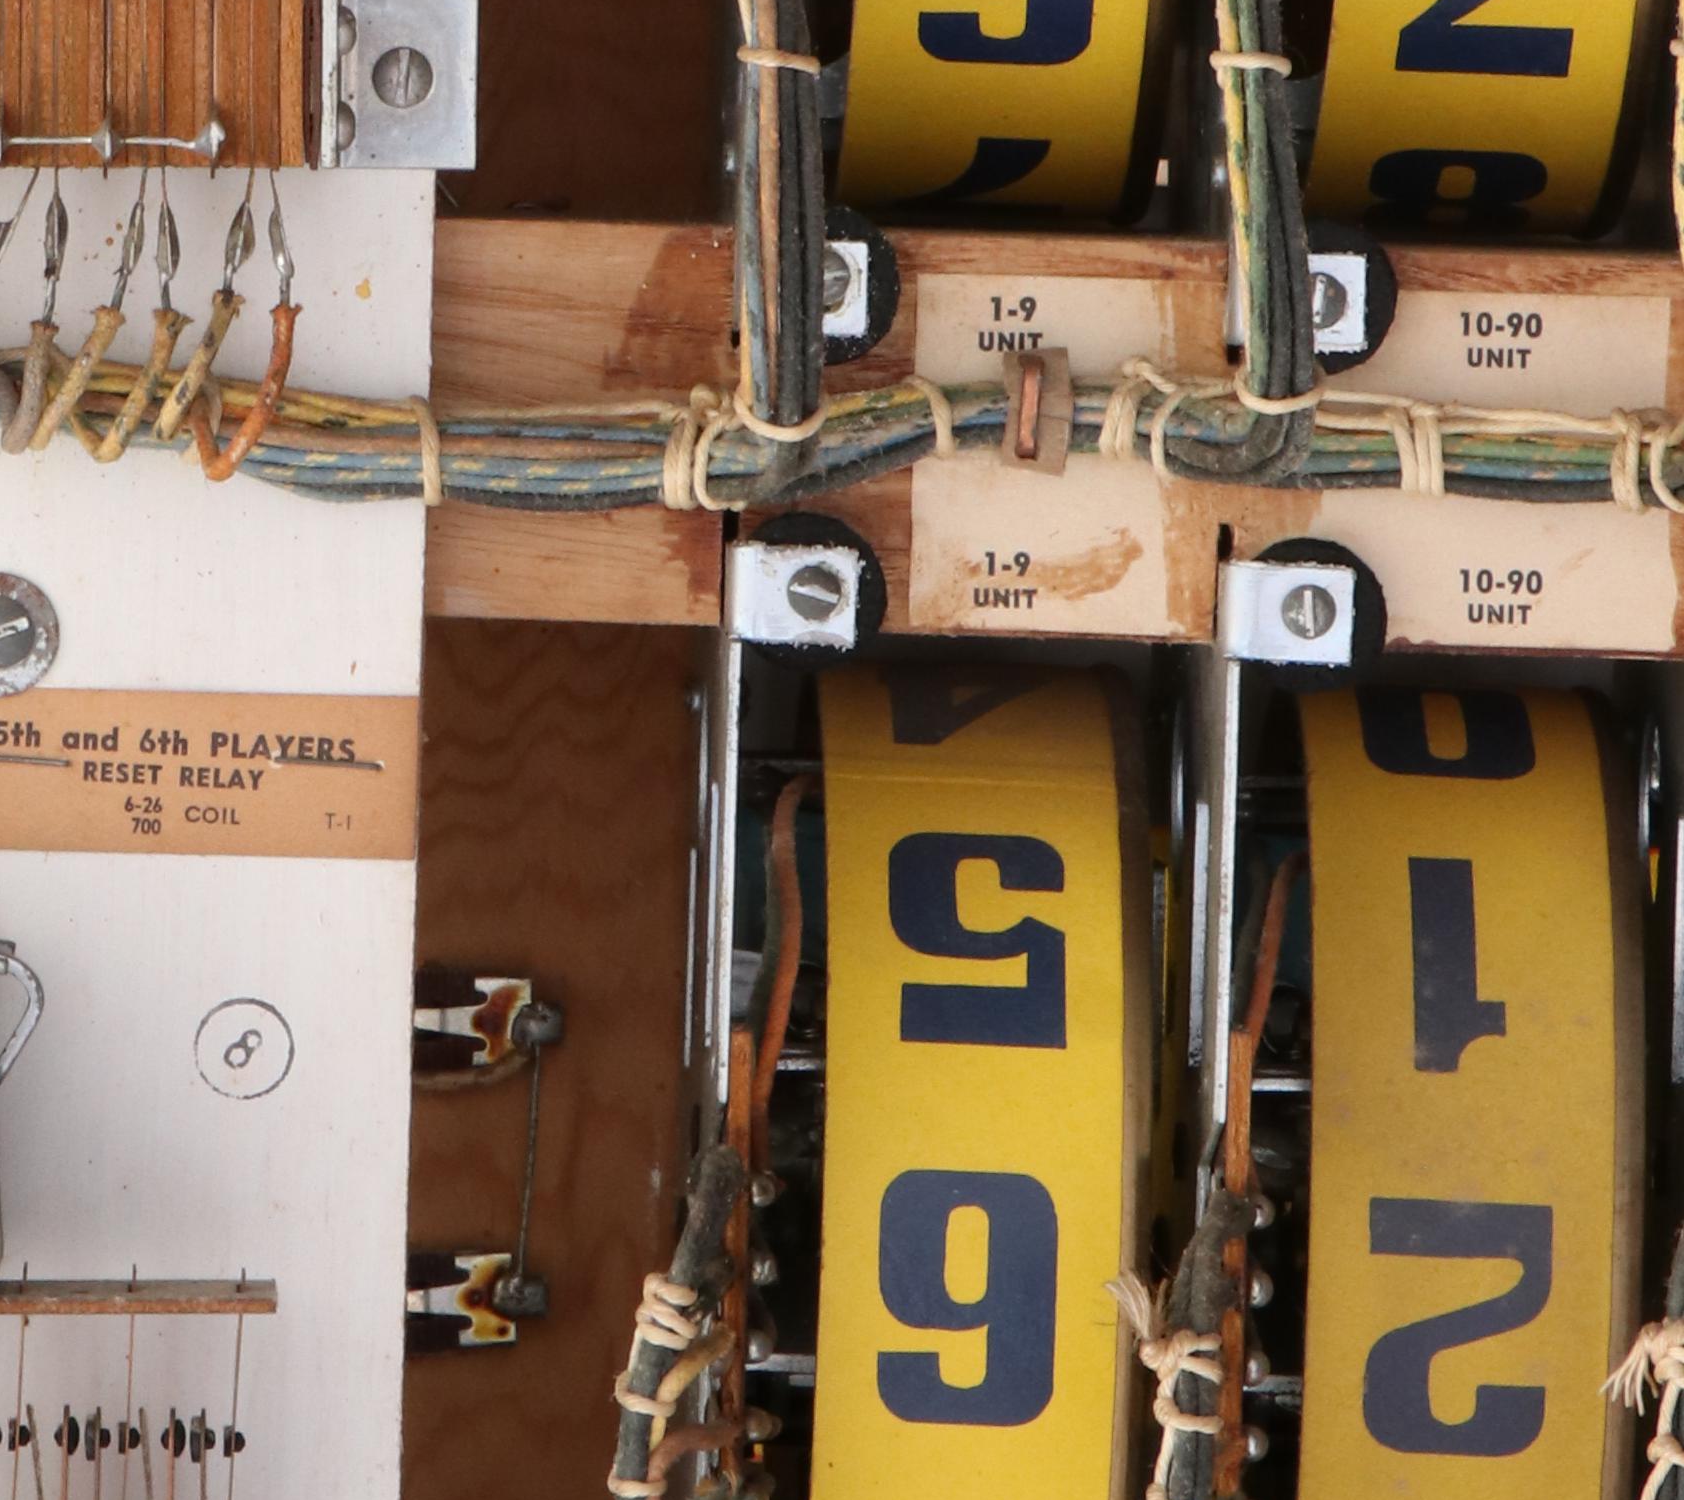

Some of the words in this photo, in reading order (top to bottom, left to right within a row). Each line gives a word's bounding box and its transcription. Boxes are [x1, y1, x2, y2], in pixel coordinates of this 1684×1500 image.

[990, 296, 1037, 323] 1-9
[1460, 311, 1543, 339] 10-90
[977, 330, 1045, 353] UNIT
[1467, 347, 1532, 369] UNIT
[984, 551, 1031, 578] 1-9
[1459, 568, 1543, 595] 10-90
[973, 587, 1038, 609] UNIT
[1467, 603, 1533, 625] UNIT
[61, 726, 120, 753] and
[139, 728, 189, 757] 6th
[210, 731, 358, 764] PLAYERS
[83, 760, 163, 785] RESET
[179, 765, 265, 791] RELAY
[123, 795, 164, 815] 6-26
[184, 805, 241, 826] COIL
[131, 816, 162, 836] 700
[888, 832, 1066, 1049] 5
[1362, 1196, 1554, 1458] 2
